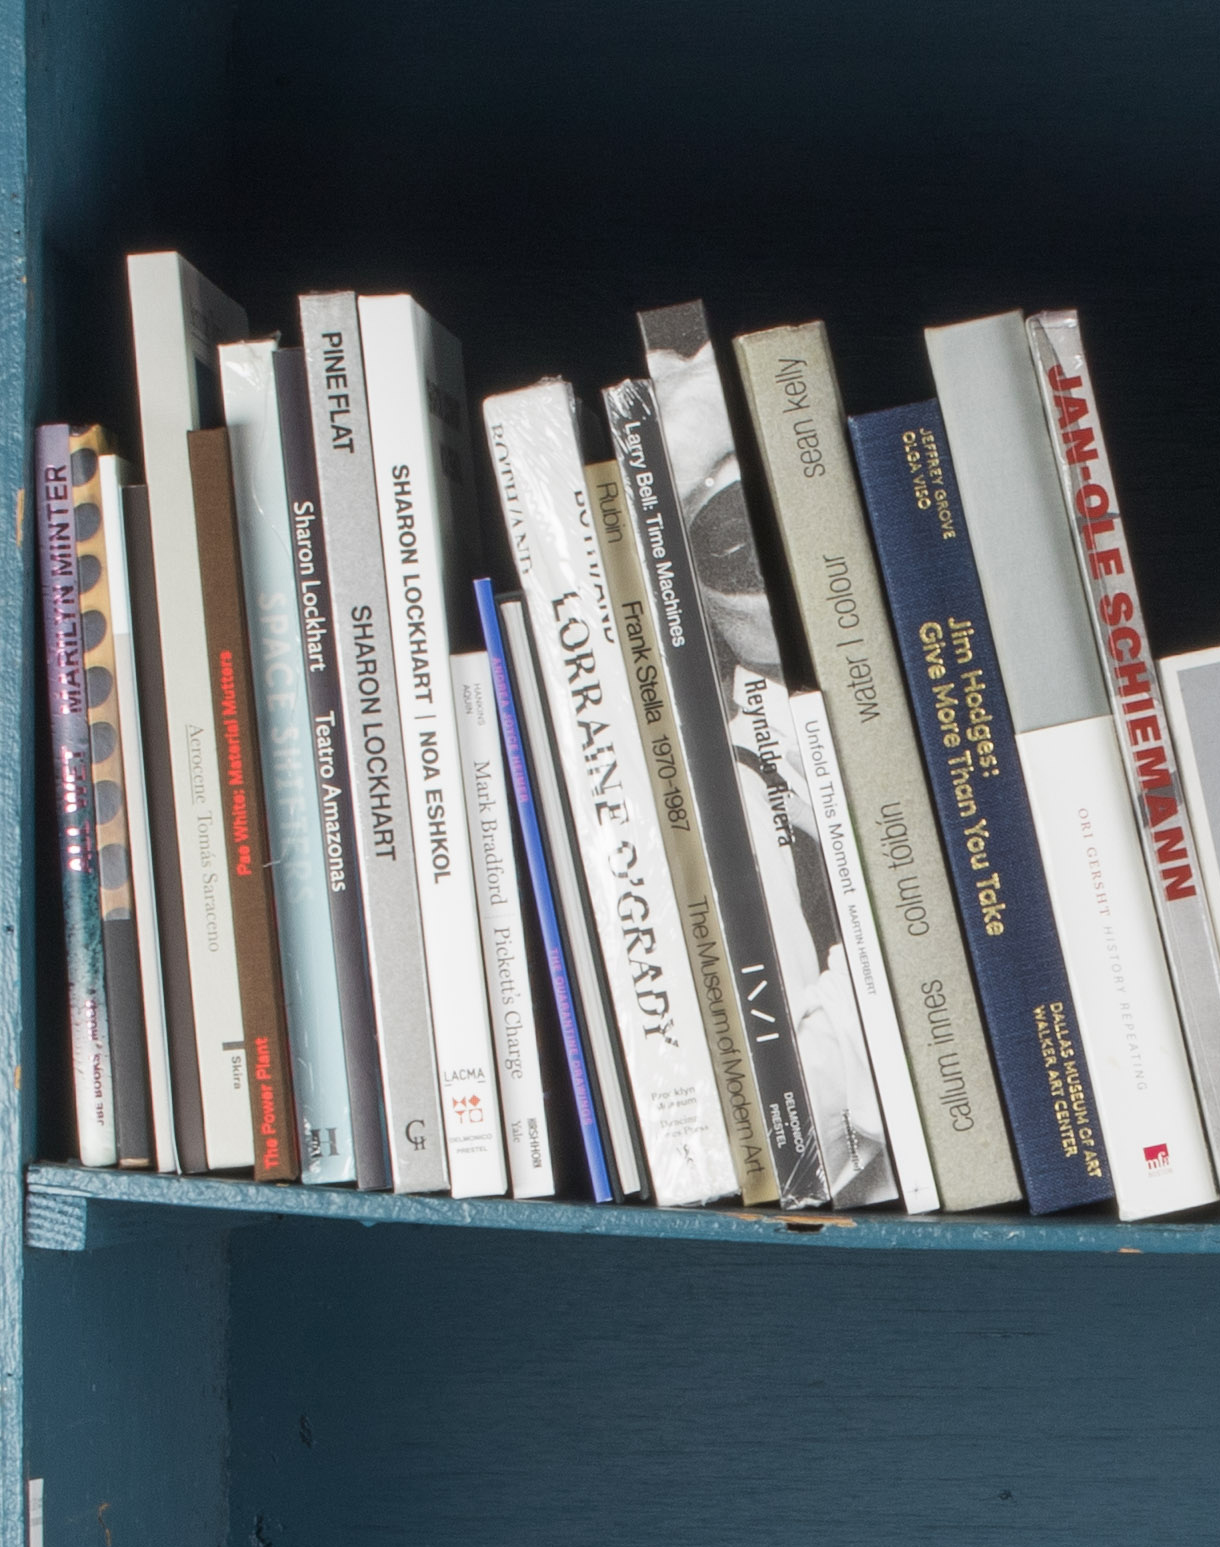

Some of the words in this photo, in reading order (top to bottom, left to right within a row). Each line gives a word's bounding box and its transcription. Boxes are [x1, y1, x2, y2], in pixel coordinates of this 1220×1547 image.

[321, 331, 348, 389] PINE
[771, 352, 816, 414] kelly
[327, 393, 354, 454] FLAT
[622, 420, 651, 470] Larry
[792, 418, 826, 480] sean
[43, 464, 73, 578] MINTER
[391, 463, 419, 565] SHARON
[594, 480, 629, 544] Rubin
[635, 470, 659, 512] Bell:
[292, 499, 320, 575] Sharon
[644, 512, 669, 560] Time
[654, 560, 688, 648] Machines
[816, 549, 861, 631] colour
[51, 581, 82, 715] MARILYN
[301, 579, 330, 672] Lockhart
[403, 573, 433, 705] LOCKHART
[619, 599, 653, 663] Frank
[916, 619, 952, 680] Give
[947, 613, 980, 665] Jim
[1045, 360, 1125, 580] JAN-OLE
[1097, 589, 1197, 902] SCHIEMANN
[350, 605, 381, 714] SHARON
[839, 651, 881, 724] water
[634, 662, 666, 724] Stella
[930, 681, 968, 748] More
[953, 668, 1004, 780] Hodges:
[187, 723, 209, 804] Aerocene
[312, 709, 339, 778] Teatro
[418, 730, 441, 781] NOA
[736, 677, 785, 777] Reynaldo
[765, 780, 799, 847] Rivera
[803, 719, 830, 778] Unfold
[362, 722, 396, 862] LOCKHART
[472, 759, 496, 813] Mark
[650, 733, 691, 835] 1970-1987
[817, 780, 839, 820] This
[946, 749, 984, 817] Than
[196, 810, 216, 868] Tomás
[321, 782, 349, 891] Amazonas
[425, 788, 451, 884] ESHKOL
[546, 590, 633, 829] LORRAINE
[600, 837, 681, 1053] O'GRADY
[871, 800, 915, 870] tóibín
[962, 818, 996, 870] You
[479, 818, 506, 906] Bradford
[827, 822, 856, 896] Moment
[201, 872, 223, 953] Saraceno
[685, 895, 715, 939] The
[847, 903, 865, 945] MARTIN
[890, 874, 930, 940] colm
[974, 872, 1011, 937] Take
[493, 926, 520, 1005] Pickett's
[695, 939, 735, 1034] Museum
[857, 946, 877, 996] HERBERT
[498, 1009, 527, 1080] Charge
[716, 1033, 740, 1056] of
[913, 976, 955, 1047] innes
[1030, 1004, 1057, 1066] WALKER
[1049, 1000, 1075, 1058] DALLAS
[251, 1036, 271, 1080] Plant
[1046, 1068, 1064, 1097] ART
[256, 1084, 276, 1135] Power
[721, 1057, 759, 1140] Modern
[929, 1050, 975, 1135] callum
[1062, 1059, 1090, 1125] MUSEUM
[261, 1138, 279, 1170] The
[739, 1141, 766, 1175] Art
[1052, 1098, 1078, 1158] CENTER
[1077, 1125, 1095, 1147] OF
[1082, 1148, 1102, 1180] ART
